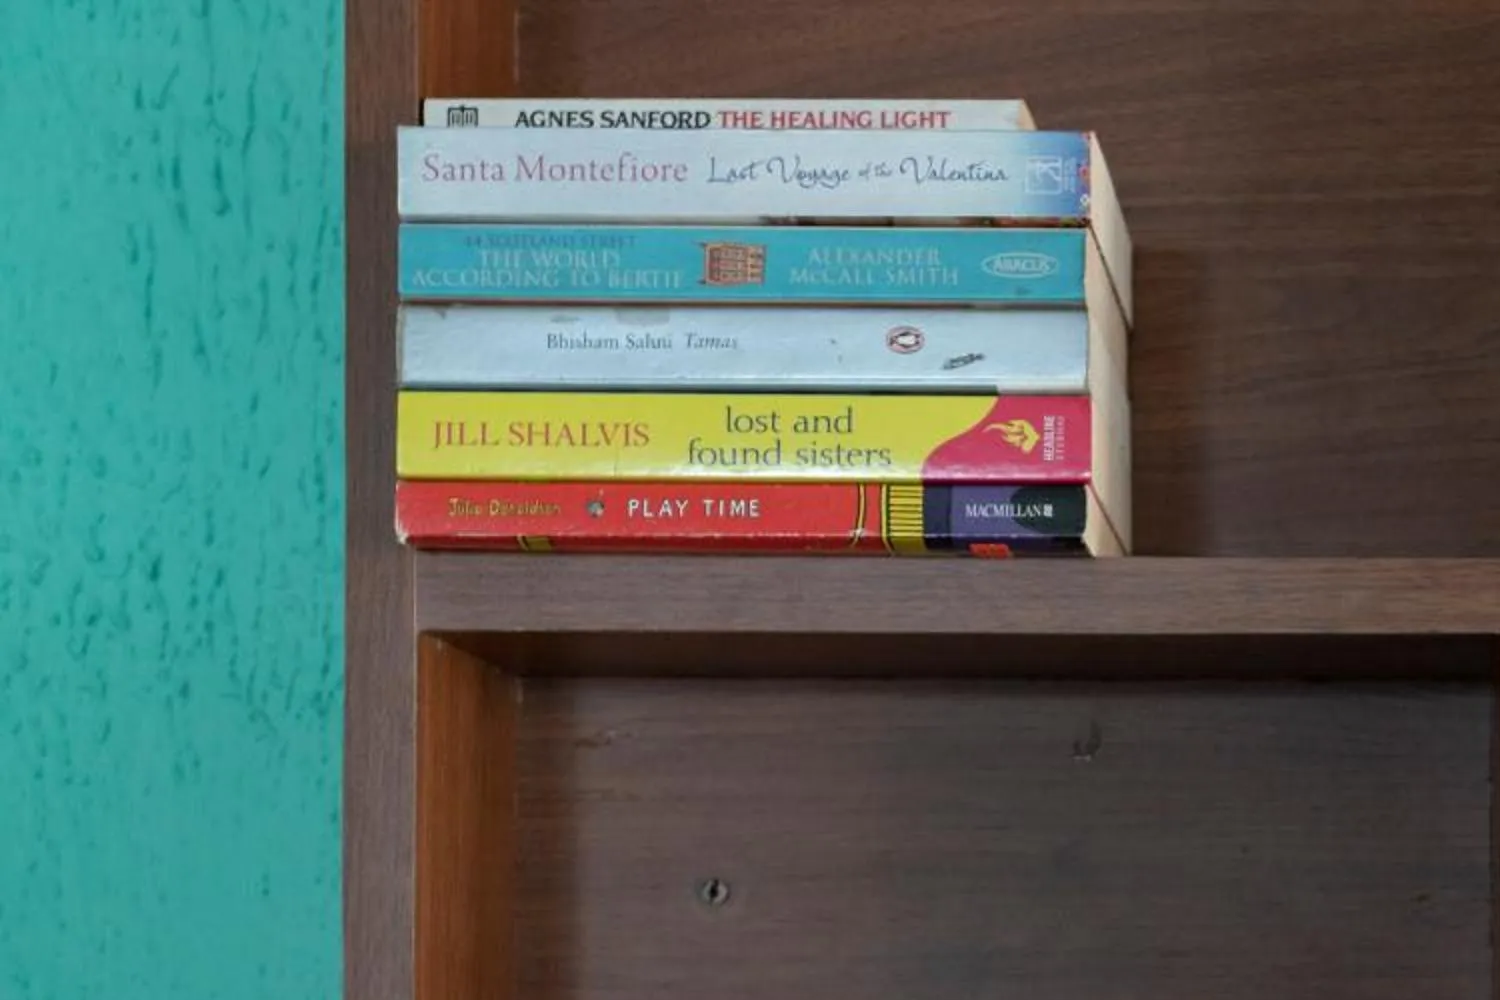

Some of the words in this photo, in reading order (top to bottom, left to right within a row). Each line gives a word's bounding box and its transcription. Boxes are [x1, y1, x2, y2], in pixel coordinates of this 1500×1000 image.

[515, 110, 594, 128] AGNES
[600, 110, 711, 128] SANFORD
[718, 110, 764, 129] THE
[771, 110, 873, 129] HEALING
[880, 110, 952, 129] LIGHT
[421, 153, 506, 182] Santa
[513, 152, 689, 182] Montefiore
[706, 156, 763, 183] Last
[766, 155, 851, 188] Voyage
[899, 155, 1009, 184] Valentina
[684, 333, 738, 350] Tamas
[726, 406, 781, 433] lost
[793, 406, 853, 433] and
[433, 420, 500, 449] JILL
[507, 421, 651, 448] SHALVIS
[688, 436, 782, 466] found
[795, 441, 892, 466] sisters
[628, 499, 689, 517] PLAY
[703, 499, 761, 517] TIME
[965, 503, 1041, 518] MACMILLAN
